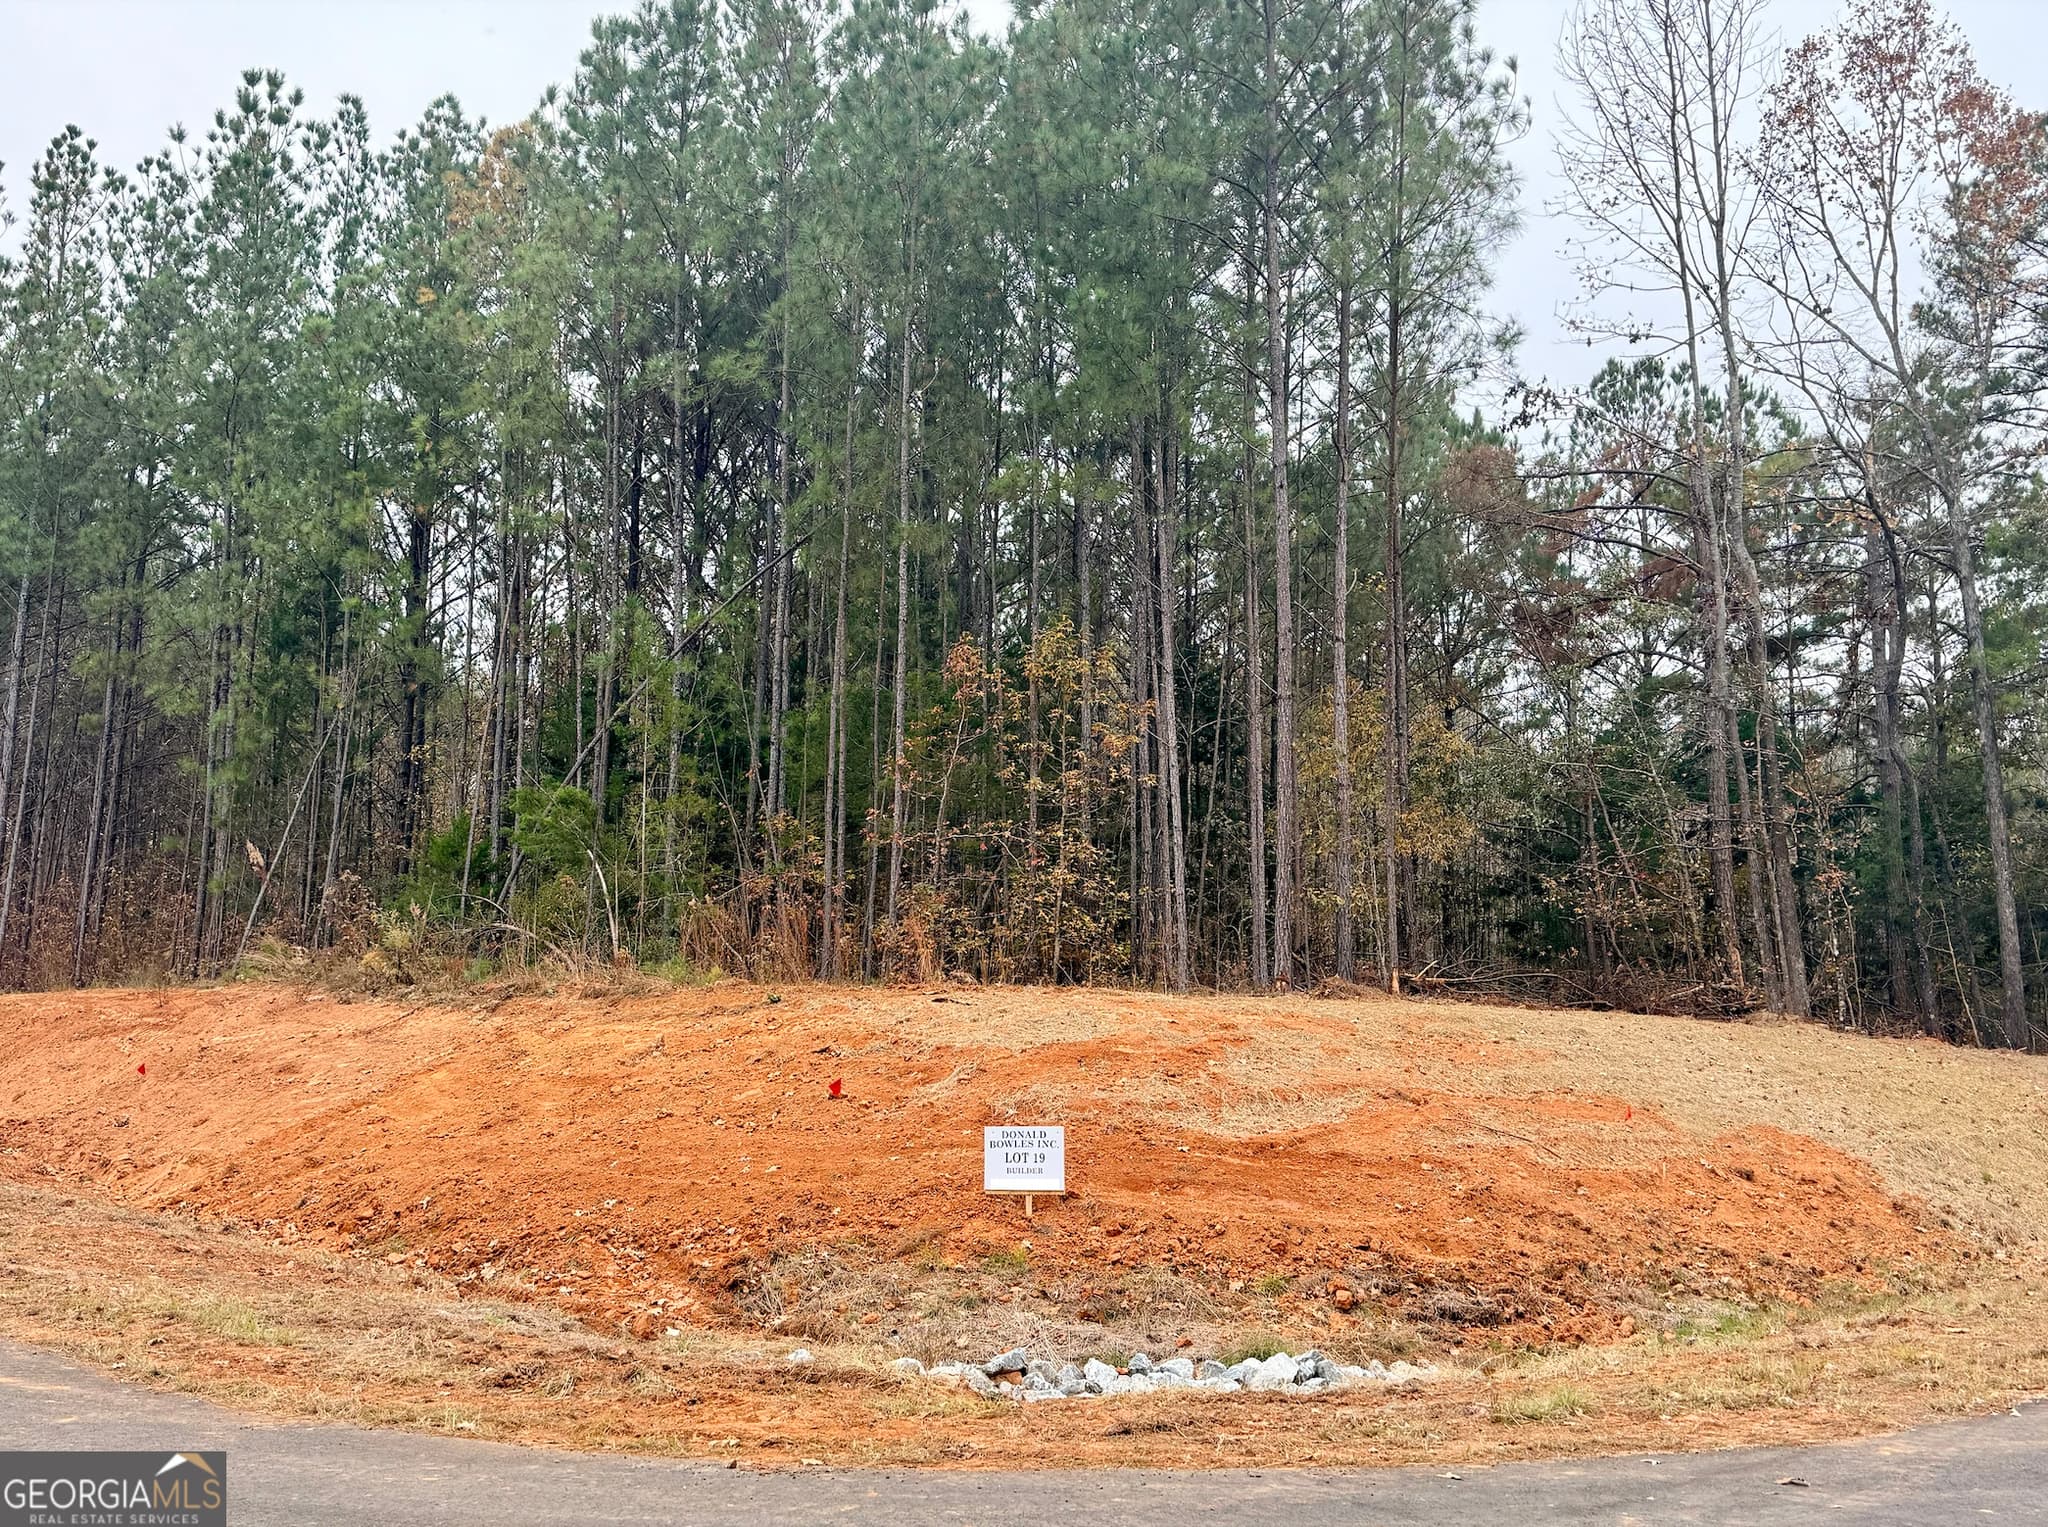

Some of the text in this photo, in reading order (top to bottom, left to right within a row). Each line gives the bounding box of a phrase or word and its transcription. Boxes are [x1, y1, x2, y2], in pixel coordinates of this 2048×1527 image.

[1001, 1130, 1047, 1139] DONALD
[989, 1140, 1060, 1149] BOWLES INC.
[1005, 1152, 1046, 1164] LOT 19
[1006, 1167, 1044, 1175] BUILDER
